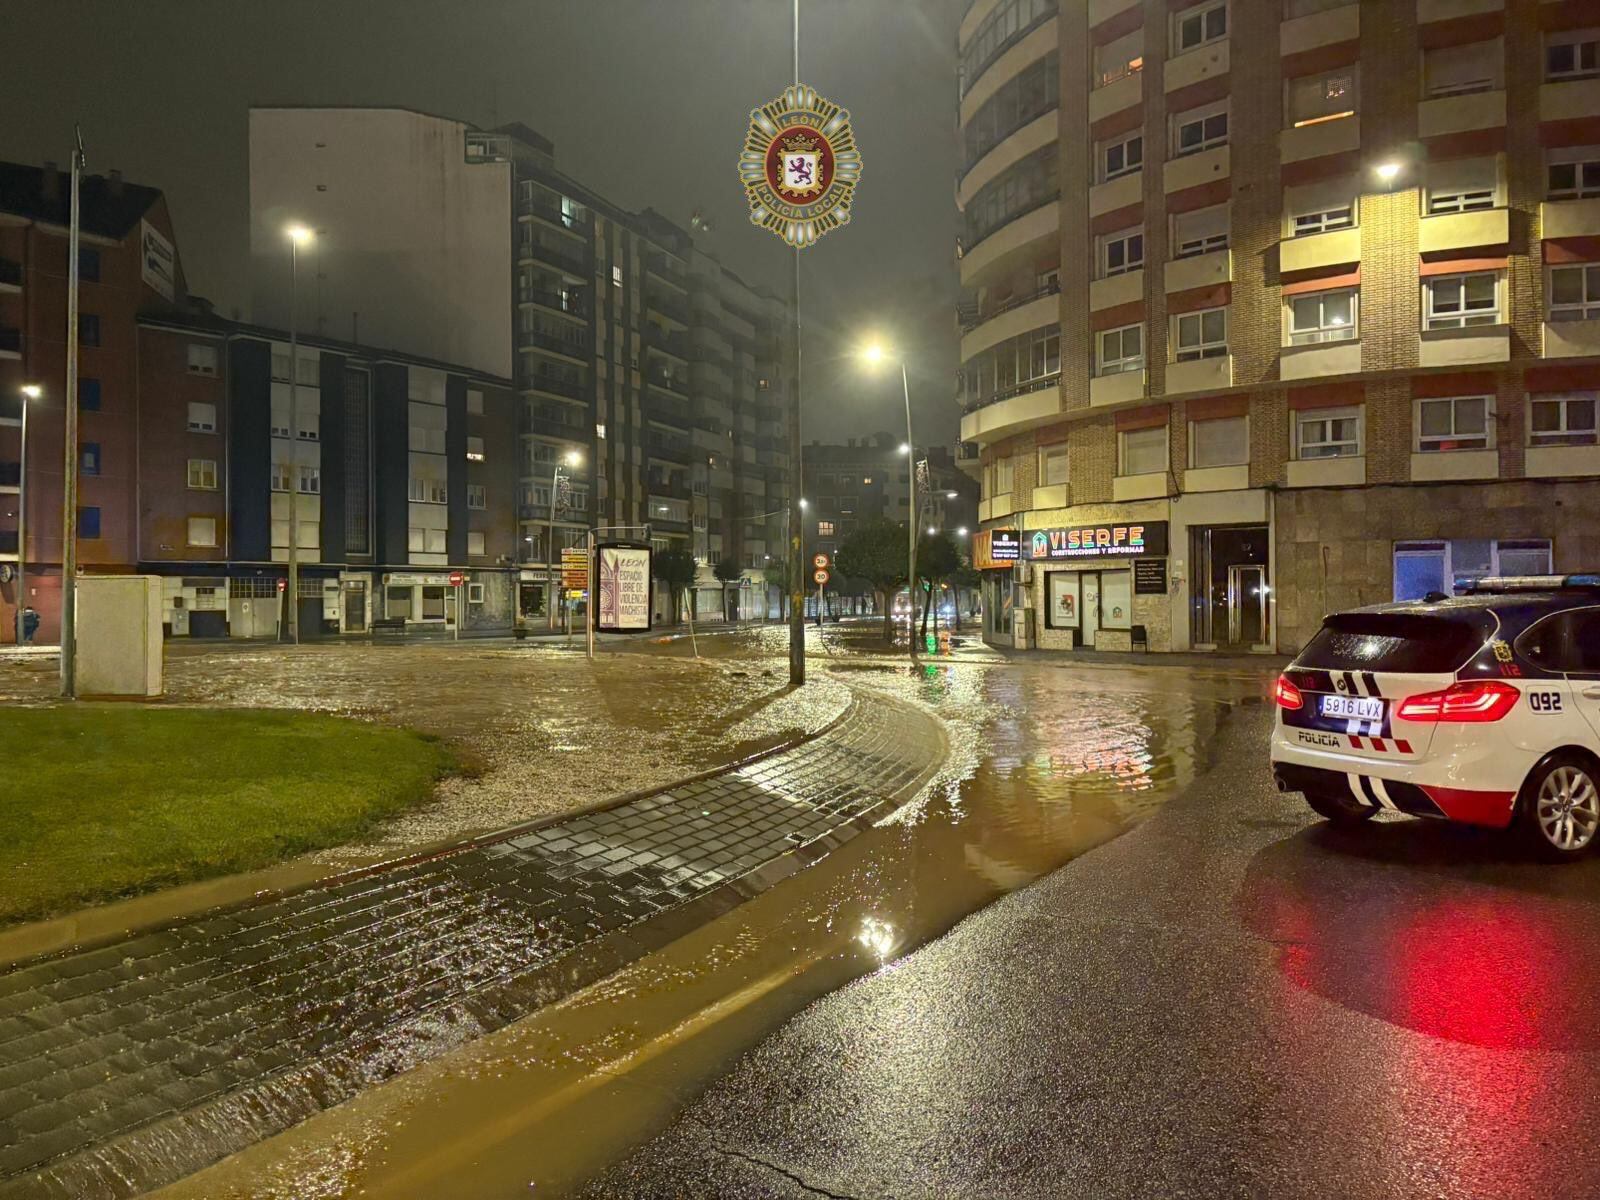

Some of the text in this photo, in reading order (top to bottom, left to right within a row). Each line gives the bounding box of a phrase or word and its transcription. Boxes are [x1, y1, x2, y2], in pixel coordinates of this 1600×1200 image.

[1049, 526, 1145, 550] VISERFE
[1051, 546, 1145, 557] CONSTRUCCIONES Y REFORMAS
[620, 571, 643, 581] ESPACIO
[620, 582, 644, 593] LIBRE DE
[620, 593, 647, 604] VIOLENCIA
[620, 605, 647, 616] MACHISTA
[1499, 664, 1521, 676] 112
[1530, 692, 1562, 711] 092
[1357, 701, 1380, 717] LVX
